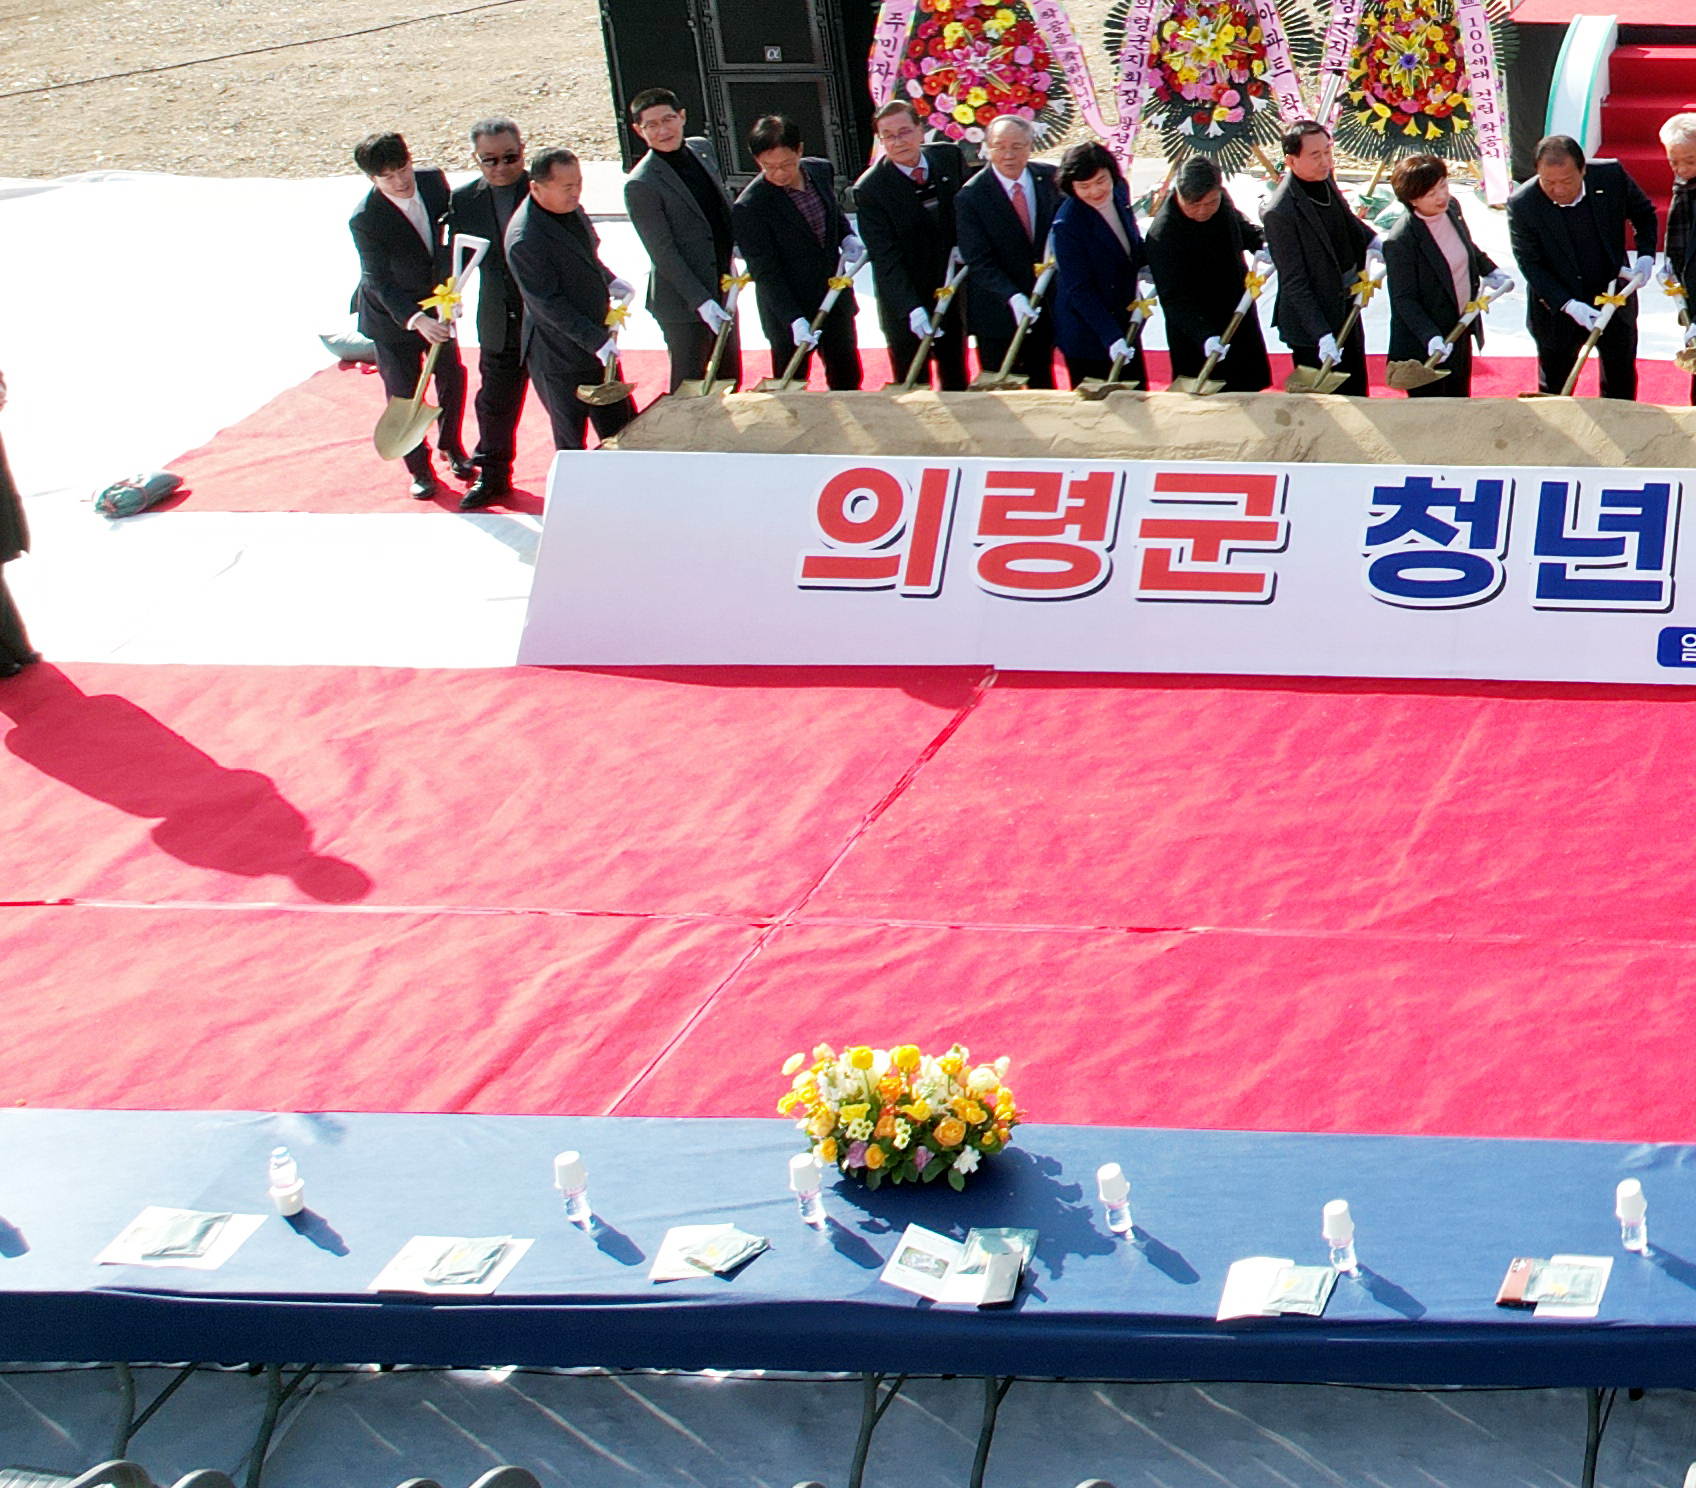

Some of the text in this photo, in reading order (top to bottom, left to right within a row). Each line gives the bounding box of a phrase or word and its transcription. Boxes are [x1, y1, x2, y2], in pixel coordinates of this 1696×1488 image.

[1466, 17, 1490, 80] 100세대
[801, 467, 1280, 593] 의령군
[1366, 477, 1666, 602] 청년
